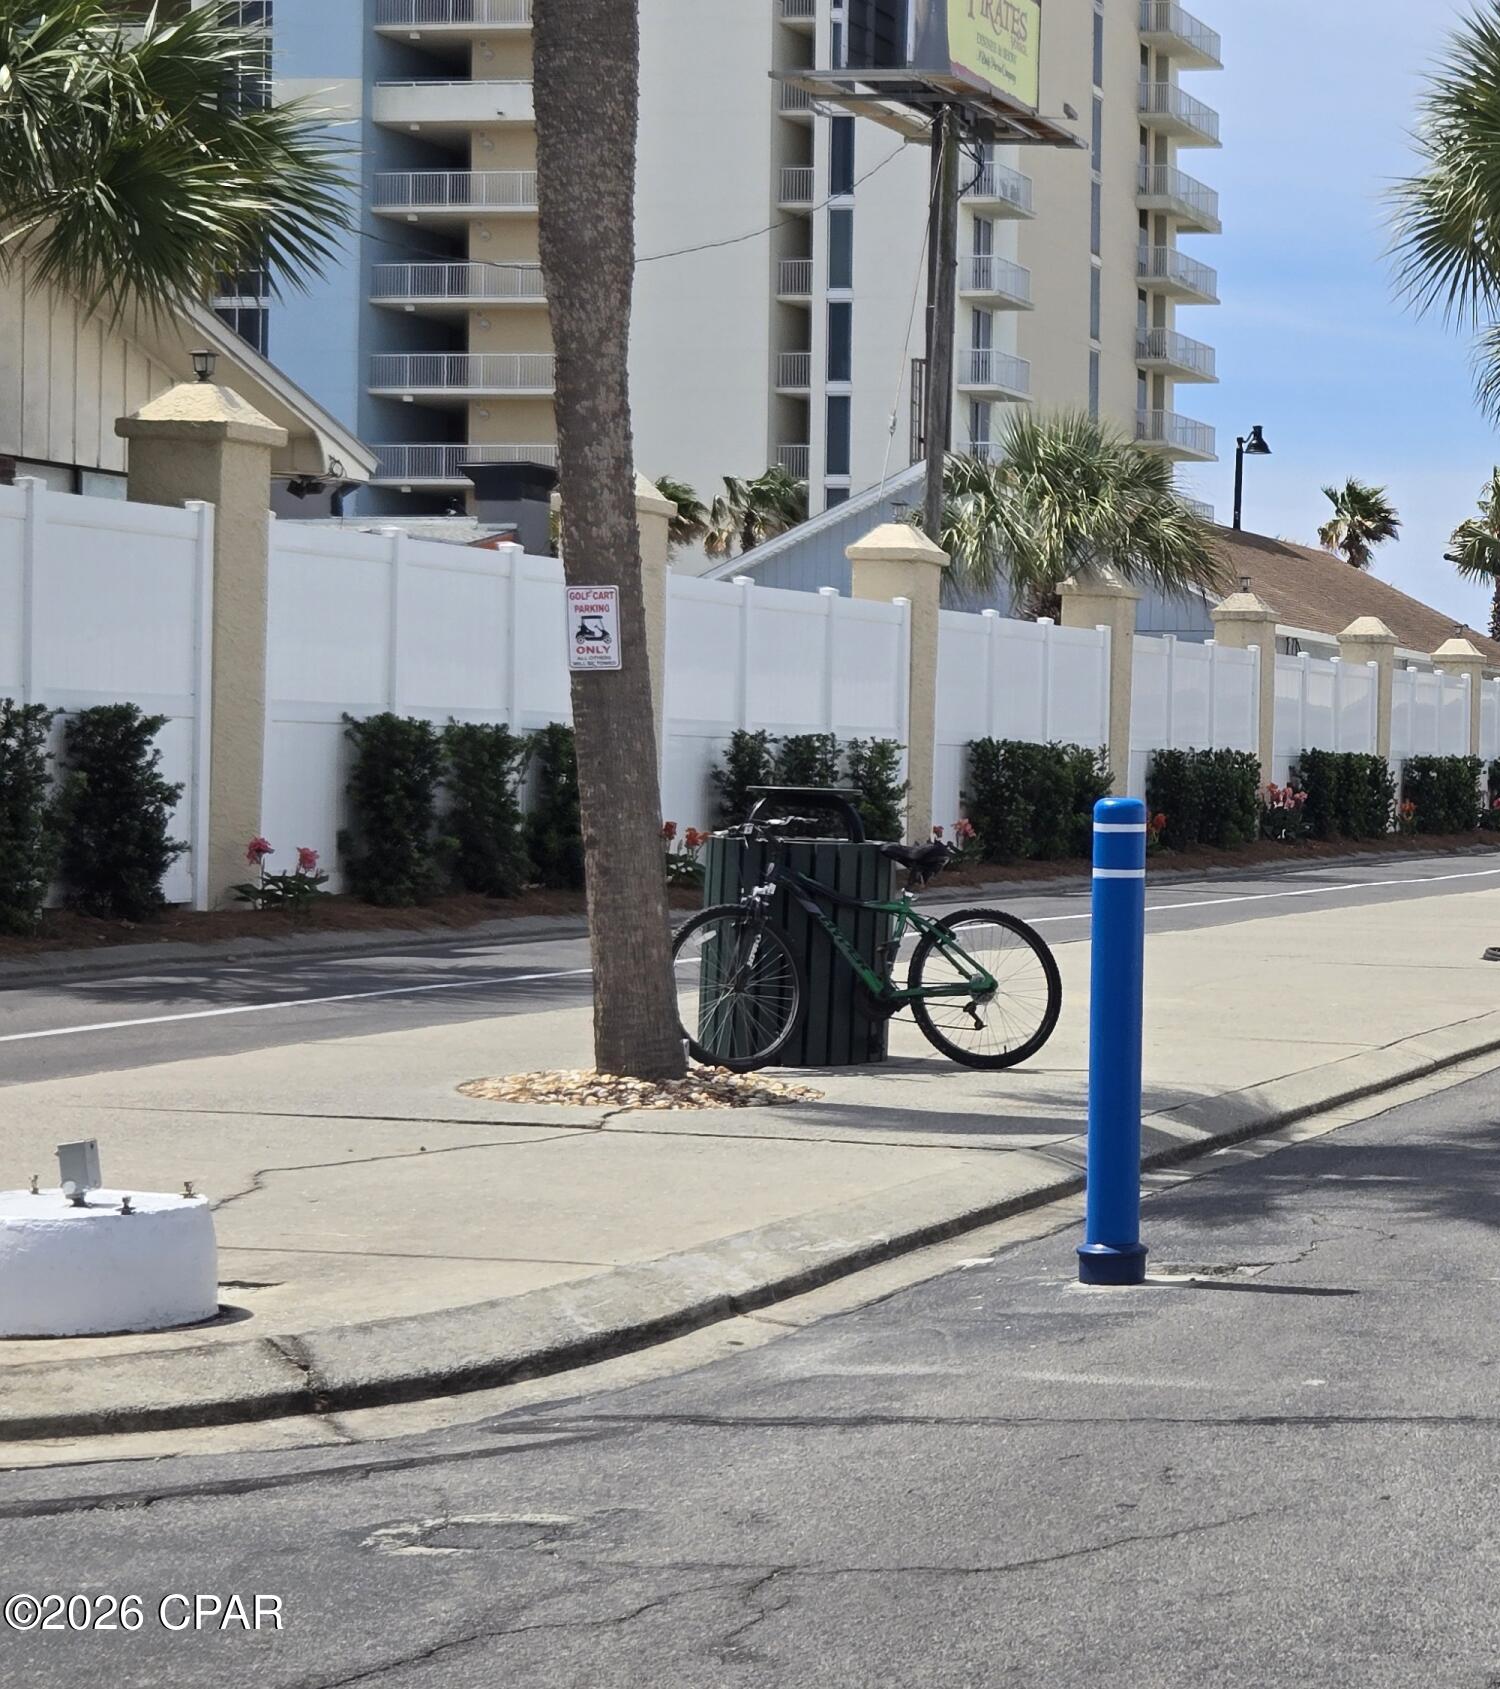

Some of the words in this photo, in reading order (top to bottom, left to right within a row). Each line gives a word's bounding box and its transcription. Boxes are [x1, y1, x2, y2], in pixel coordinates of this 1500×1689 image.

[569, 591, 591, 601] GOLF
[592, 590, 614, 600] CART
[574, 604, 610, 613] PARKING
[576, 645, 611, 655] ONLY
